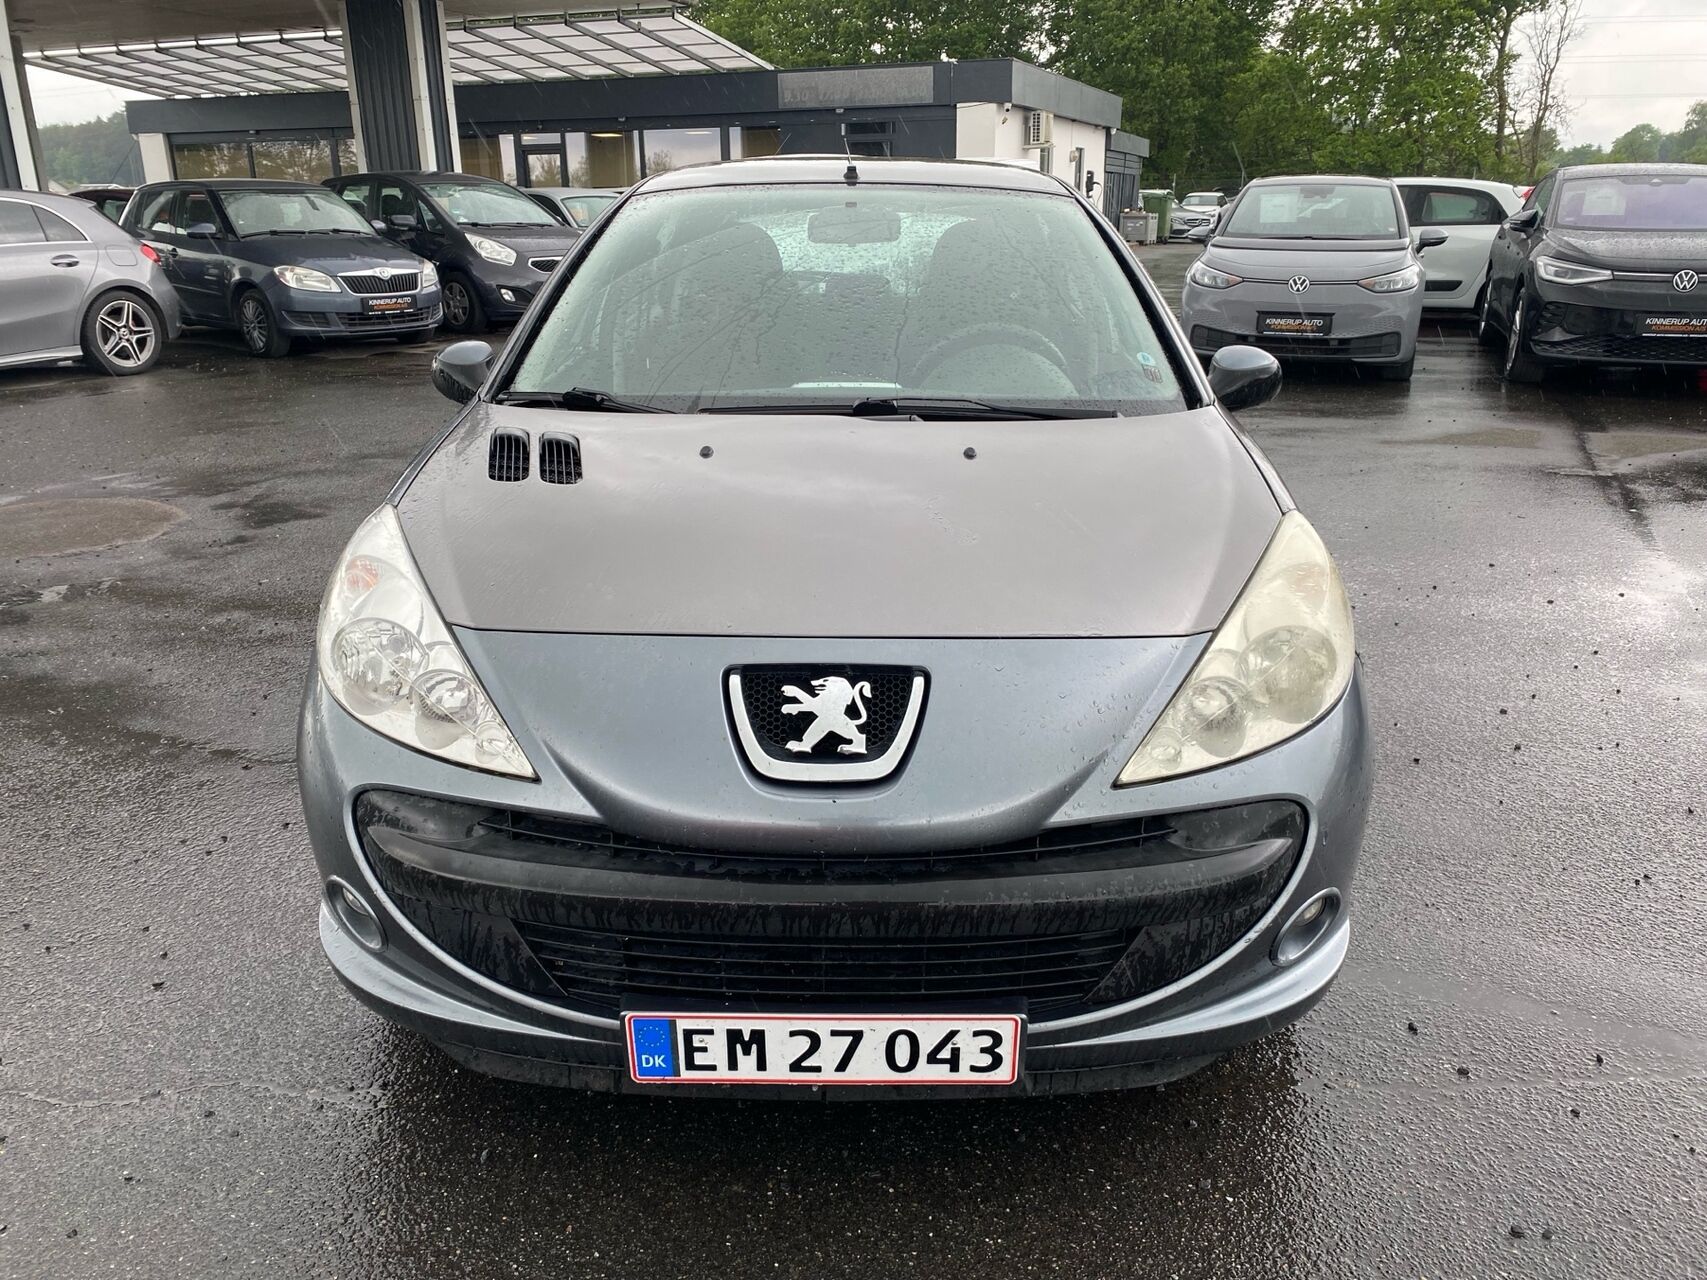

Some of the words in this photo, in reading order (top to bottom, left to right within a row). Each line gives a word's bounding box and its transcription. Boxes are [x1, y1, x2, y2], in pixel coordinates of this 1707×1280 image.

[642, 1054, 667, 1068] DK
[682, 1028, 768, 1072] EM
[788, 1029, 864, 1073] 27
[885, 1029, 1004, 1074] 043
